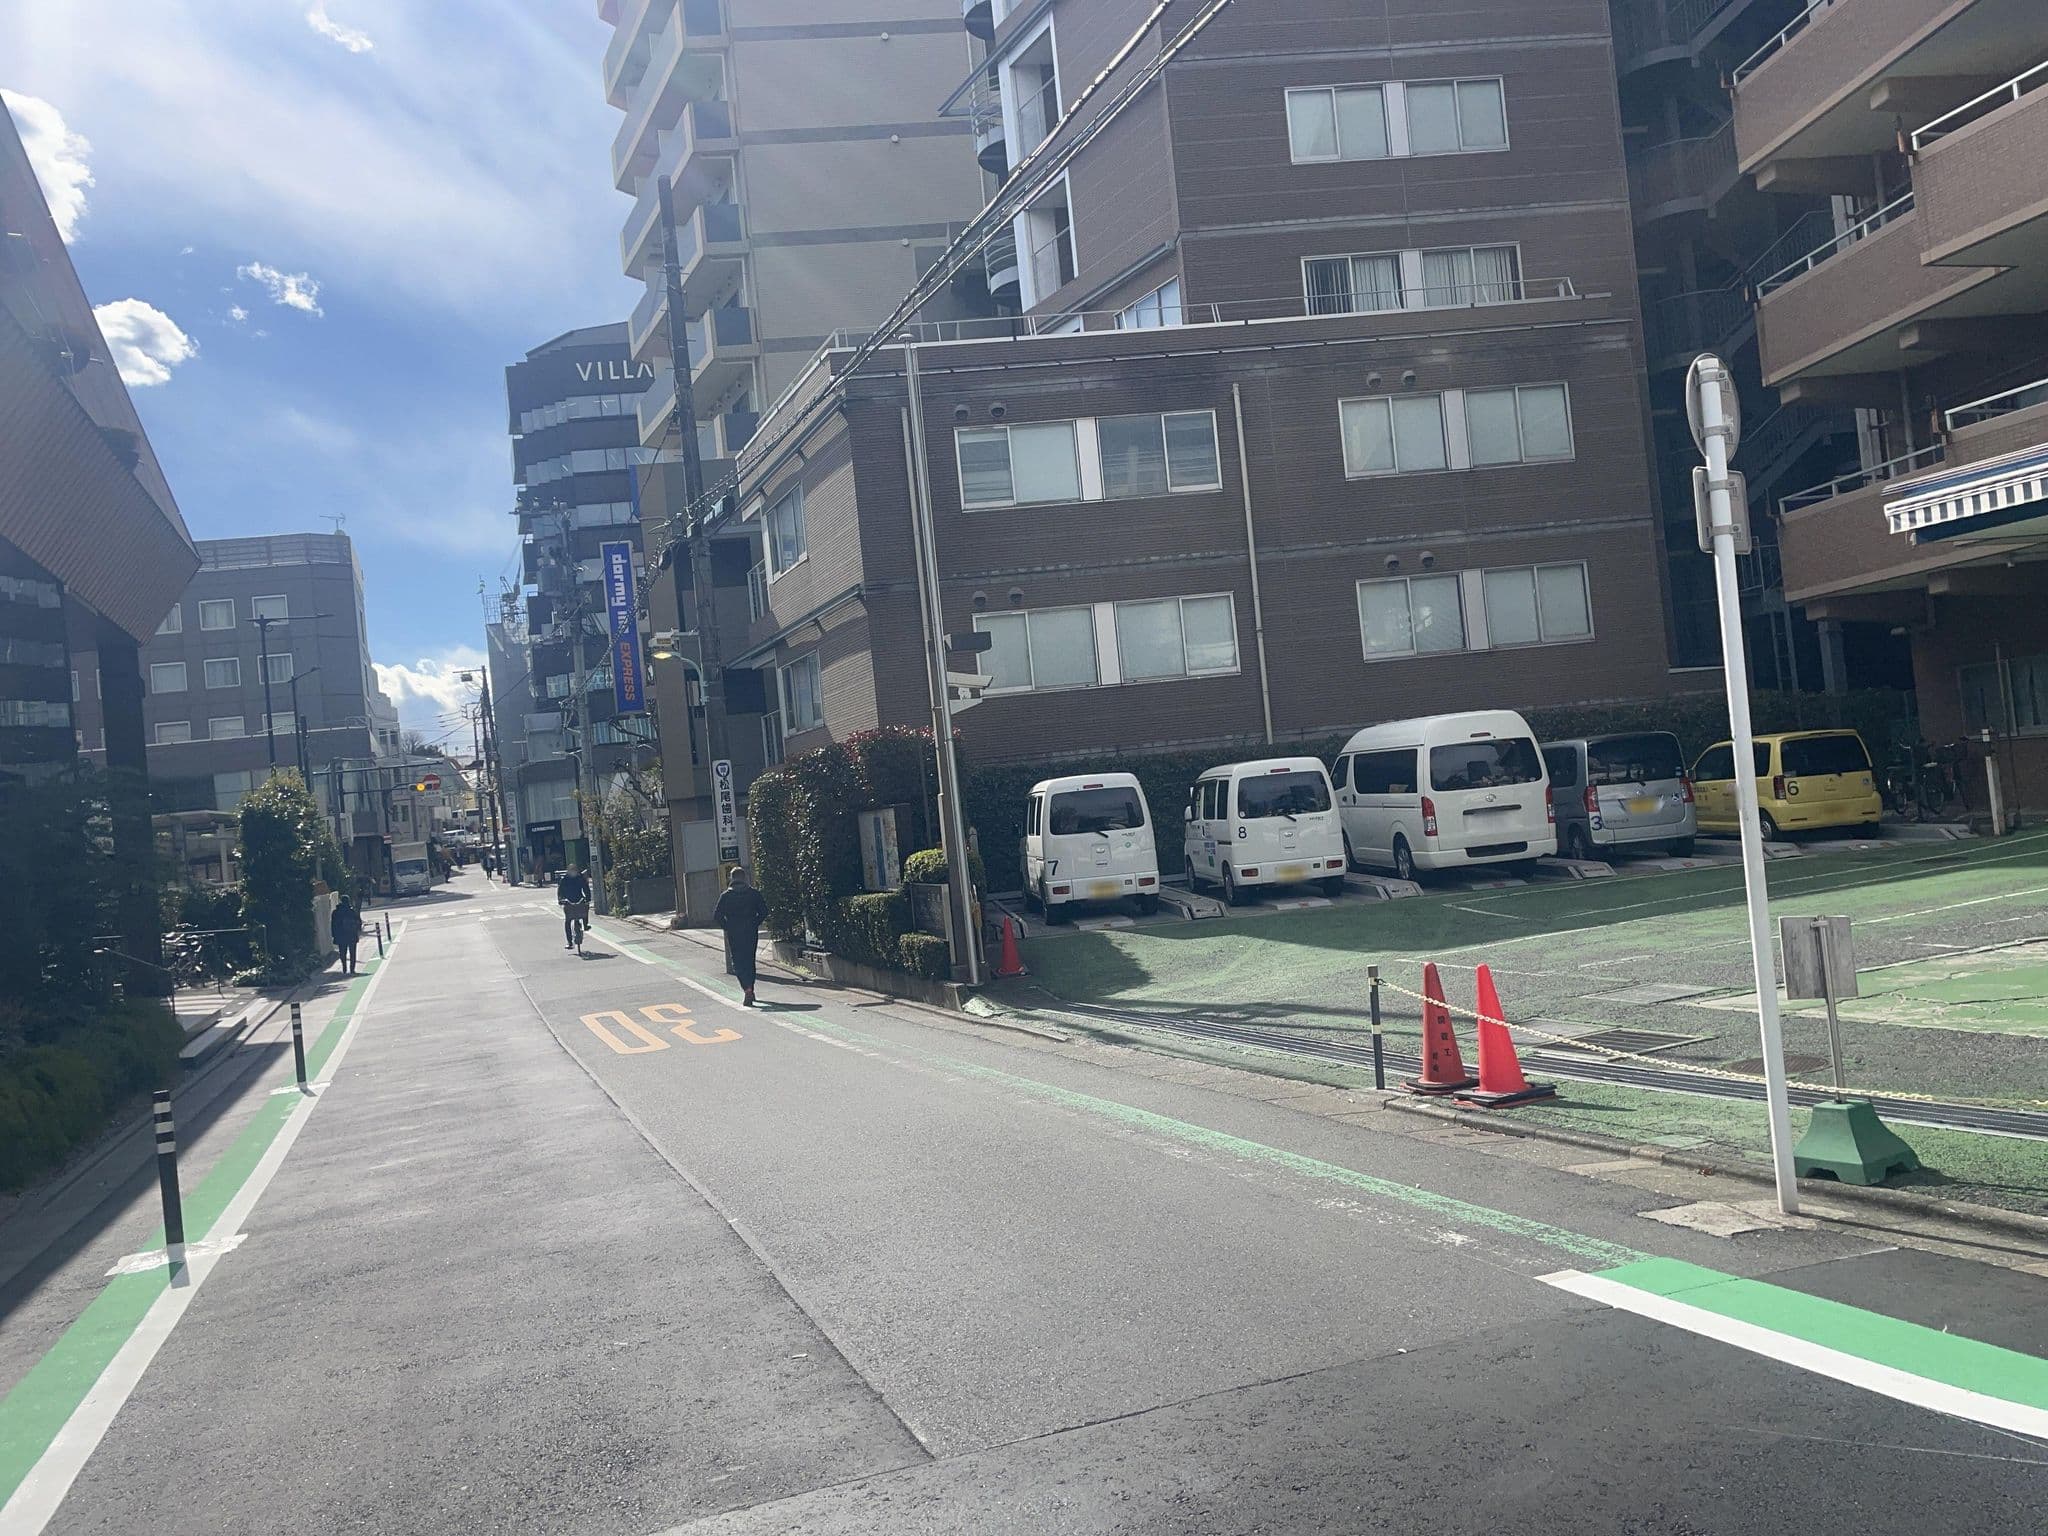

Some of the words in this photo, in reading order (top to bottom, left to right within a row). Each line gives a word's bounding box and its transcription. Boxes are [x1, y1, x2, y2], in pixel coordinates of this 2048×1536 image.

[576, 359, 654, 382] VILLA
[611, 554, 627, 607] dormy
[620, 641, 636, 701] EXPRESS
[1787, 780, 1800, 796] 6
[719, 777, 733, 826] 松尾歯科
[1238, 826, 1248, 839] 8
[1590, 815, 1603, 831] 3
[1047, 859, 1059, 876] 7
[579, 1003, 743, 1055] 30
